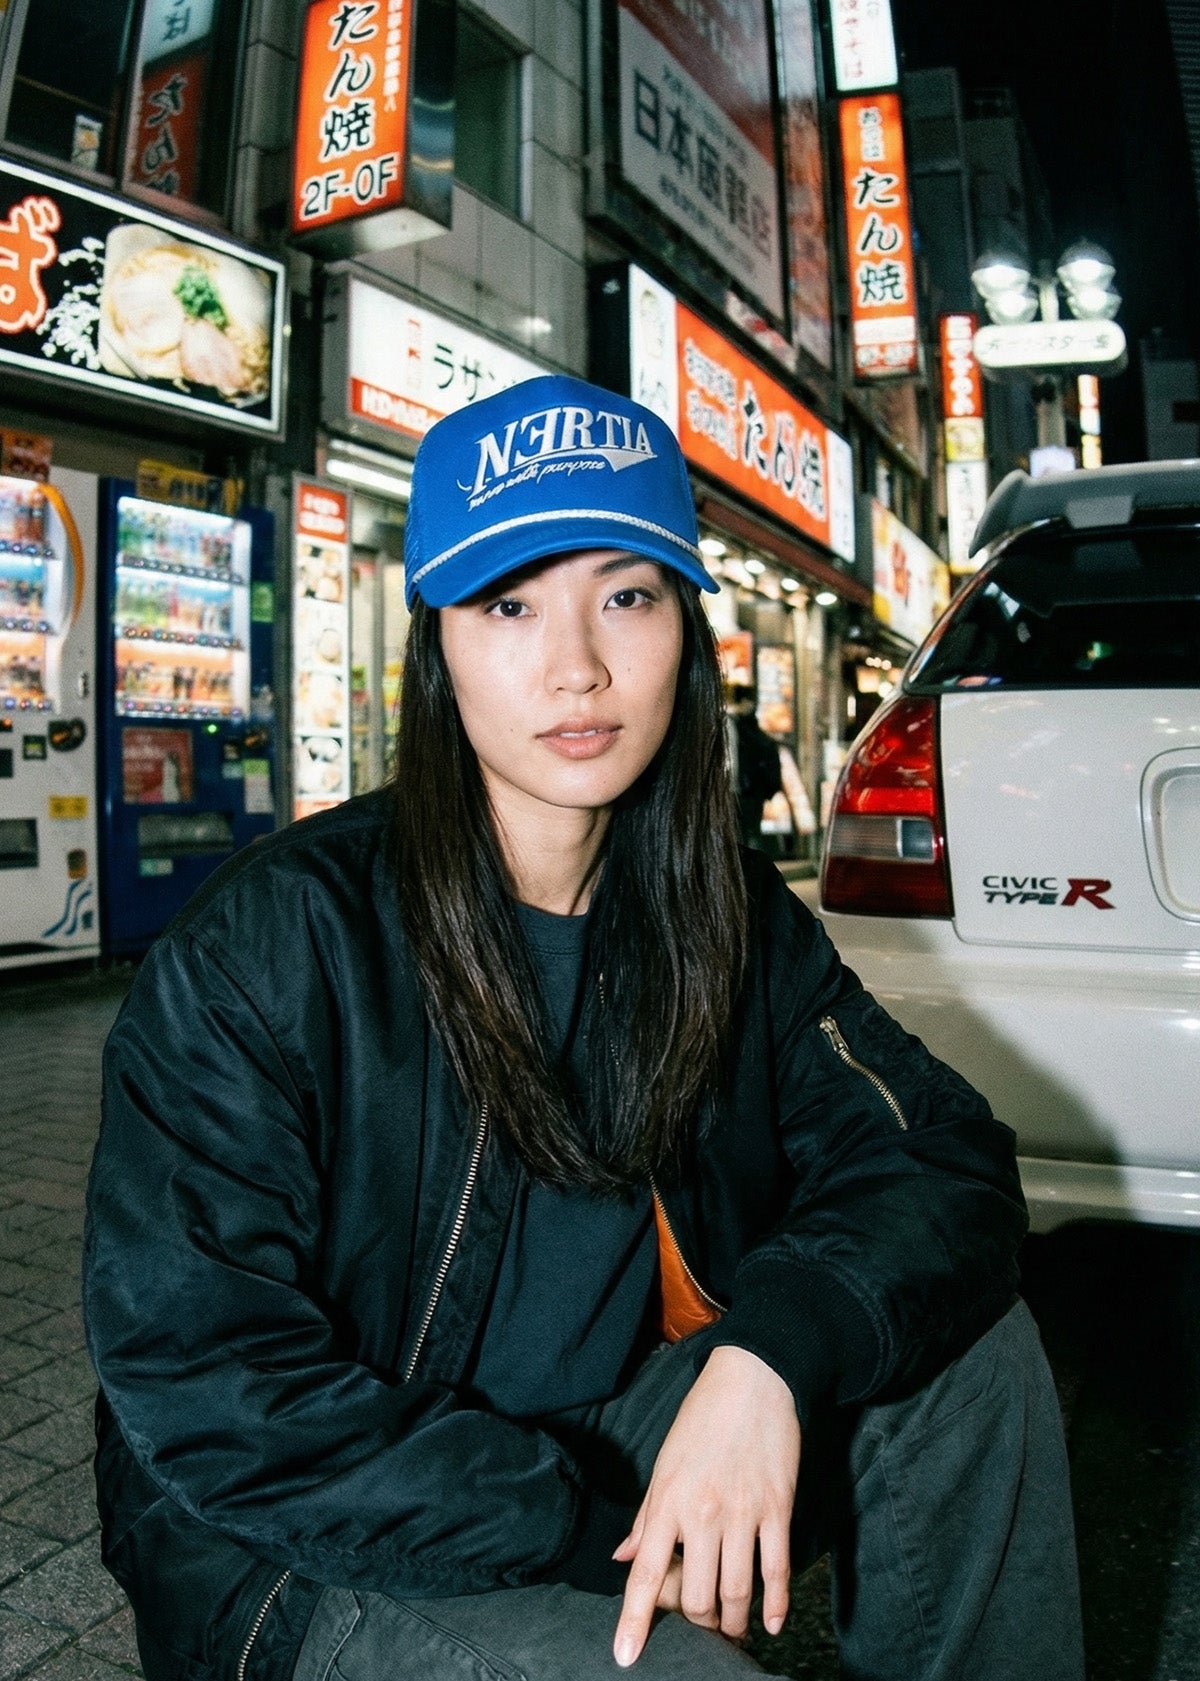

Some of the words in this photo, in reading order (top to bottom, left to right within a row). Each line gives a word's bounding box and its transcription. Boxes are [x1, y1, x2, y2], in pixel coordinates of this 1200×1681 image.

[323, 3, 378, 158] たん焼
[856, 171, 904, 303] たん焼
[537, 459, 607, 484] purpose
[982, 875, 1058, 891] CIVIC
[984, 891, 1060, 905] TYPE
[1060, 878, 1117, 910] R
